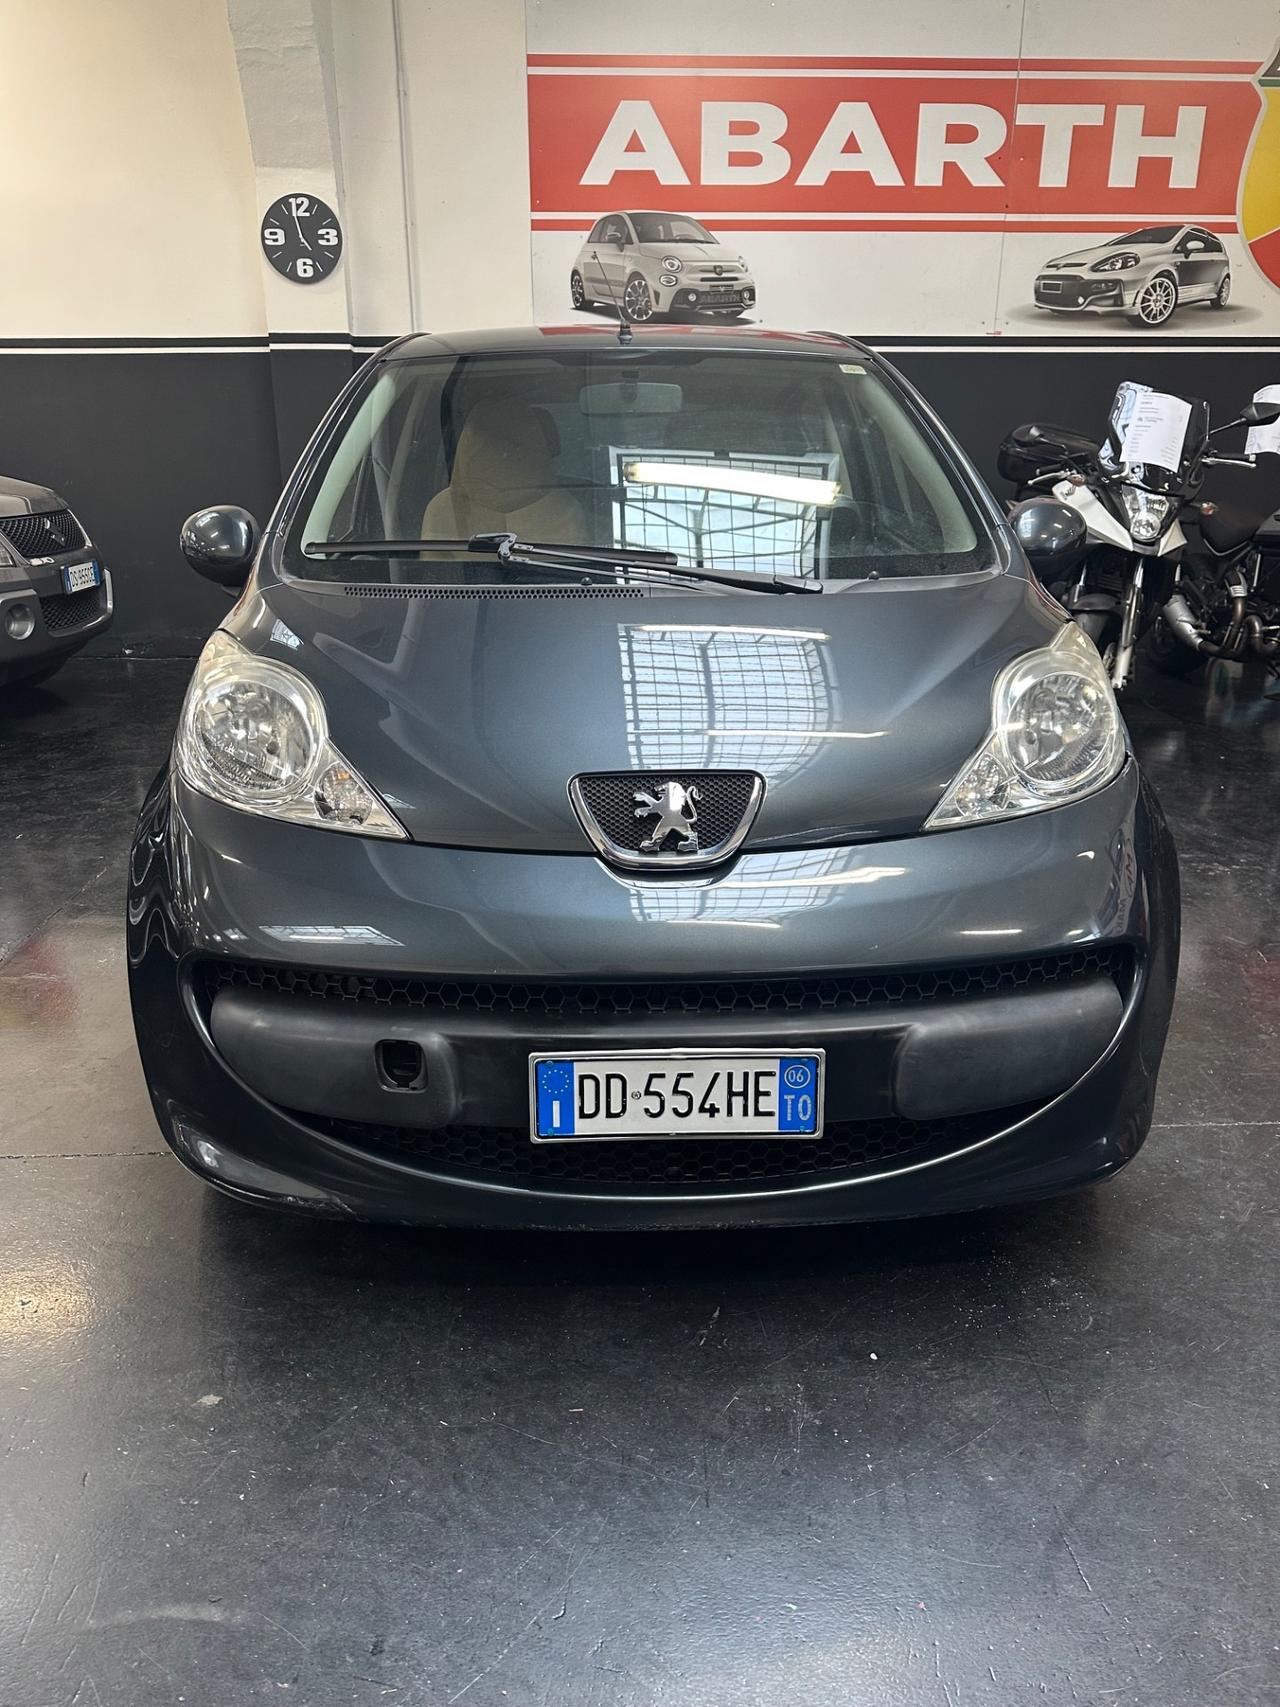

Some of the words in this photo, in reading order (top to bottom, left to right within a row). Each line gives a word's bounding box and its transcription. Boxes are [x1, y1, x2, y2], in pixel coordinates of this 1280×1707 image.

[579, 99, 1207, 188] ABARTH
[288, 197, 310, 217] 12
[264, 228, 286, 246] 9
[317, 228, 338, 246] 3
[296, 258, 314, 278] 6
[787, 1068, 804, 1083] 06
[783, 1094, 813, 1121] TO
